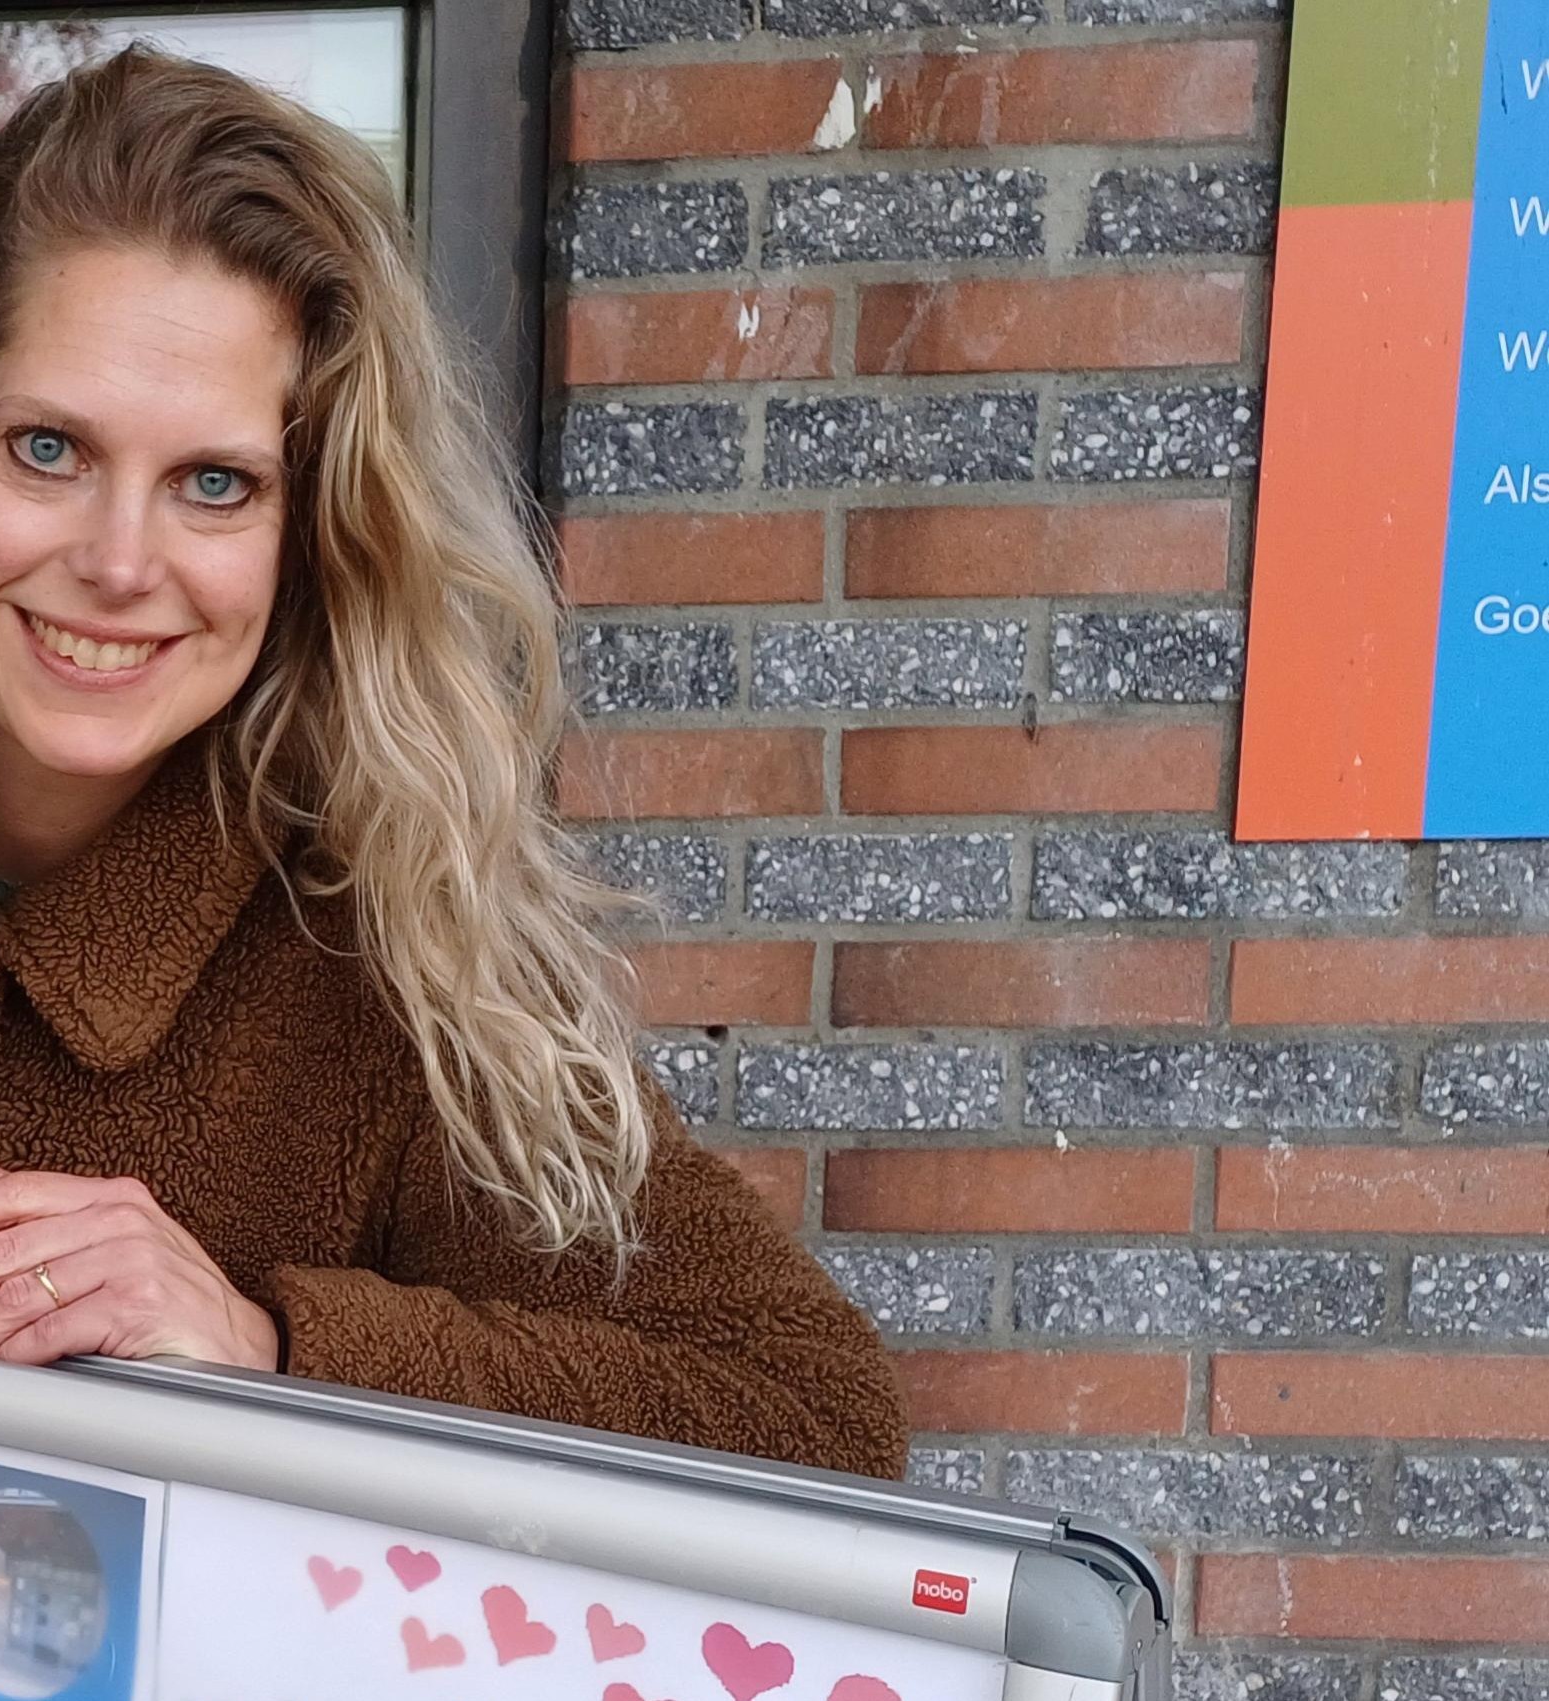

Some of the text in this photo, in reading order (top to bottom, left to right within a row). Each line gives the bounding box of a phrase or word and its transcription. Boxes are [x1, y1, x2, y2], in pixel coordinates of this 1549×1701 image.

[1498, 330, 1549, 372] W
[1483, 463, 1549, 504] Als
[916, 1580, 964, 1602] nobo
